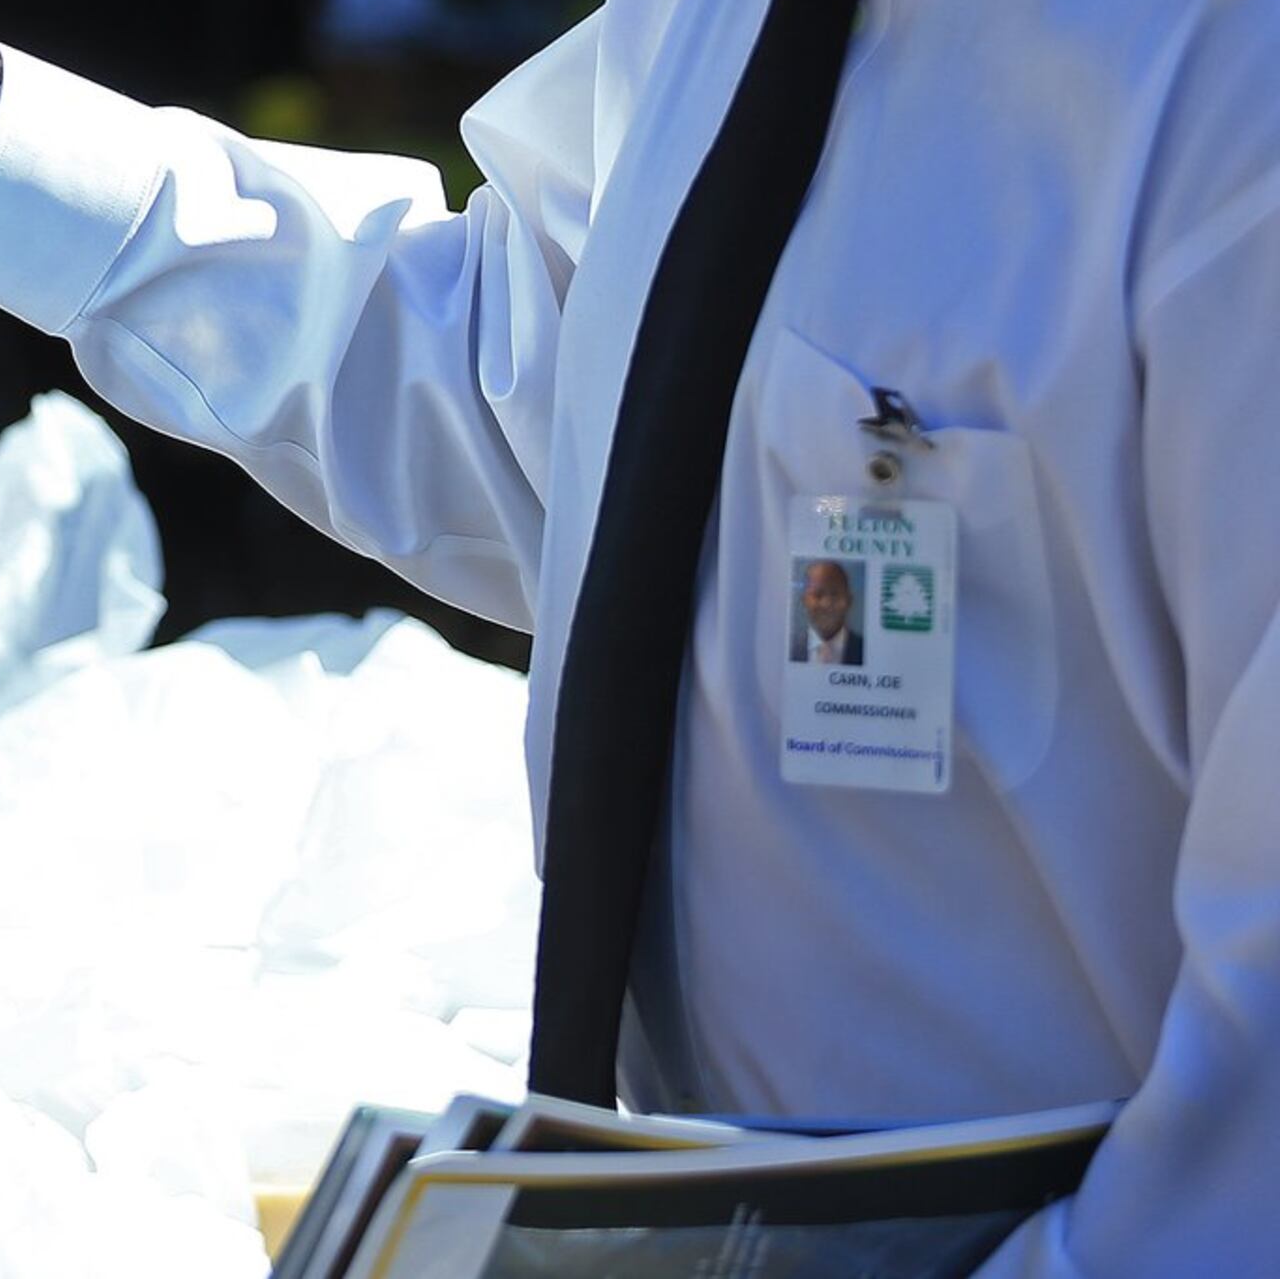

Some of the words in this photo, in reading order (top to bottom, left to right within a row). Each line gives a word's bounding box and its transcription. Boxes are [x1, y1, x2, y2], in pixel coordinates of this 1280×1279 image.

[827, 514, 915, 535] FULTON
[822, 535, 914, 558] COUNTY
[814, 701, 918, 721] COMMISSIONER
[786, 738, 825, 754] Board
[827, 740, 843, 755] of
